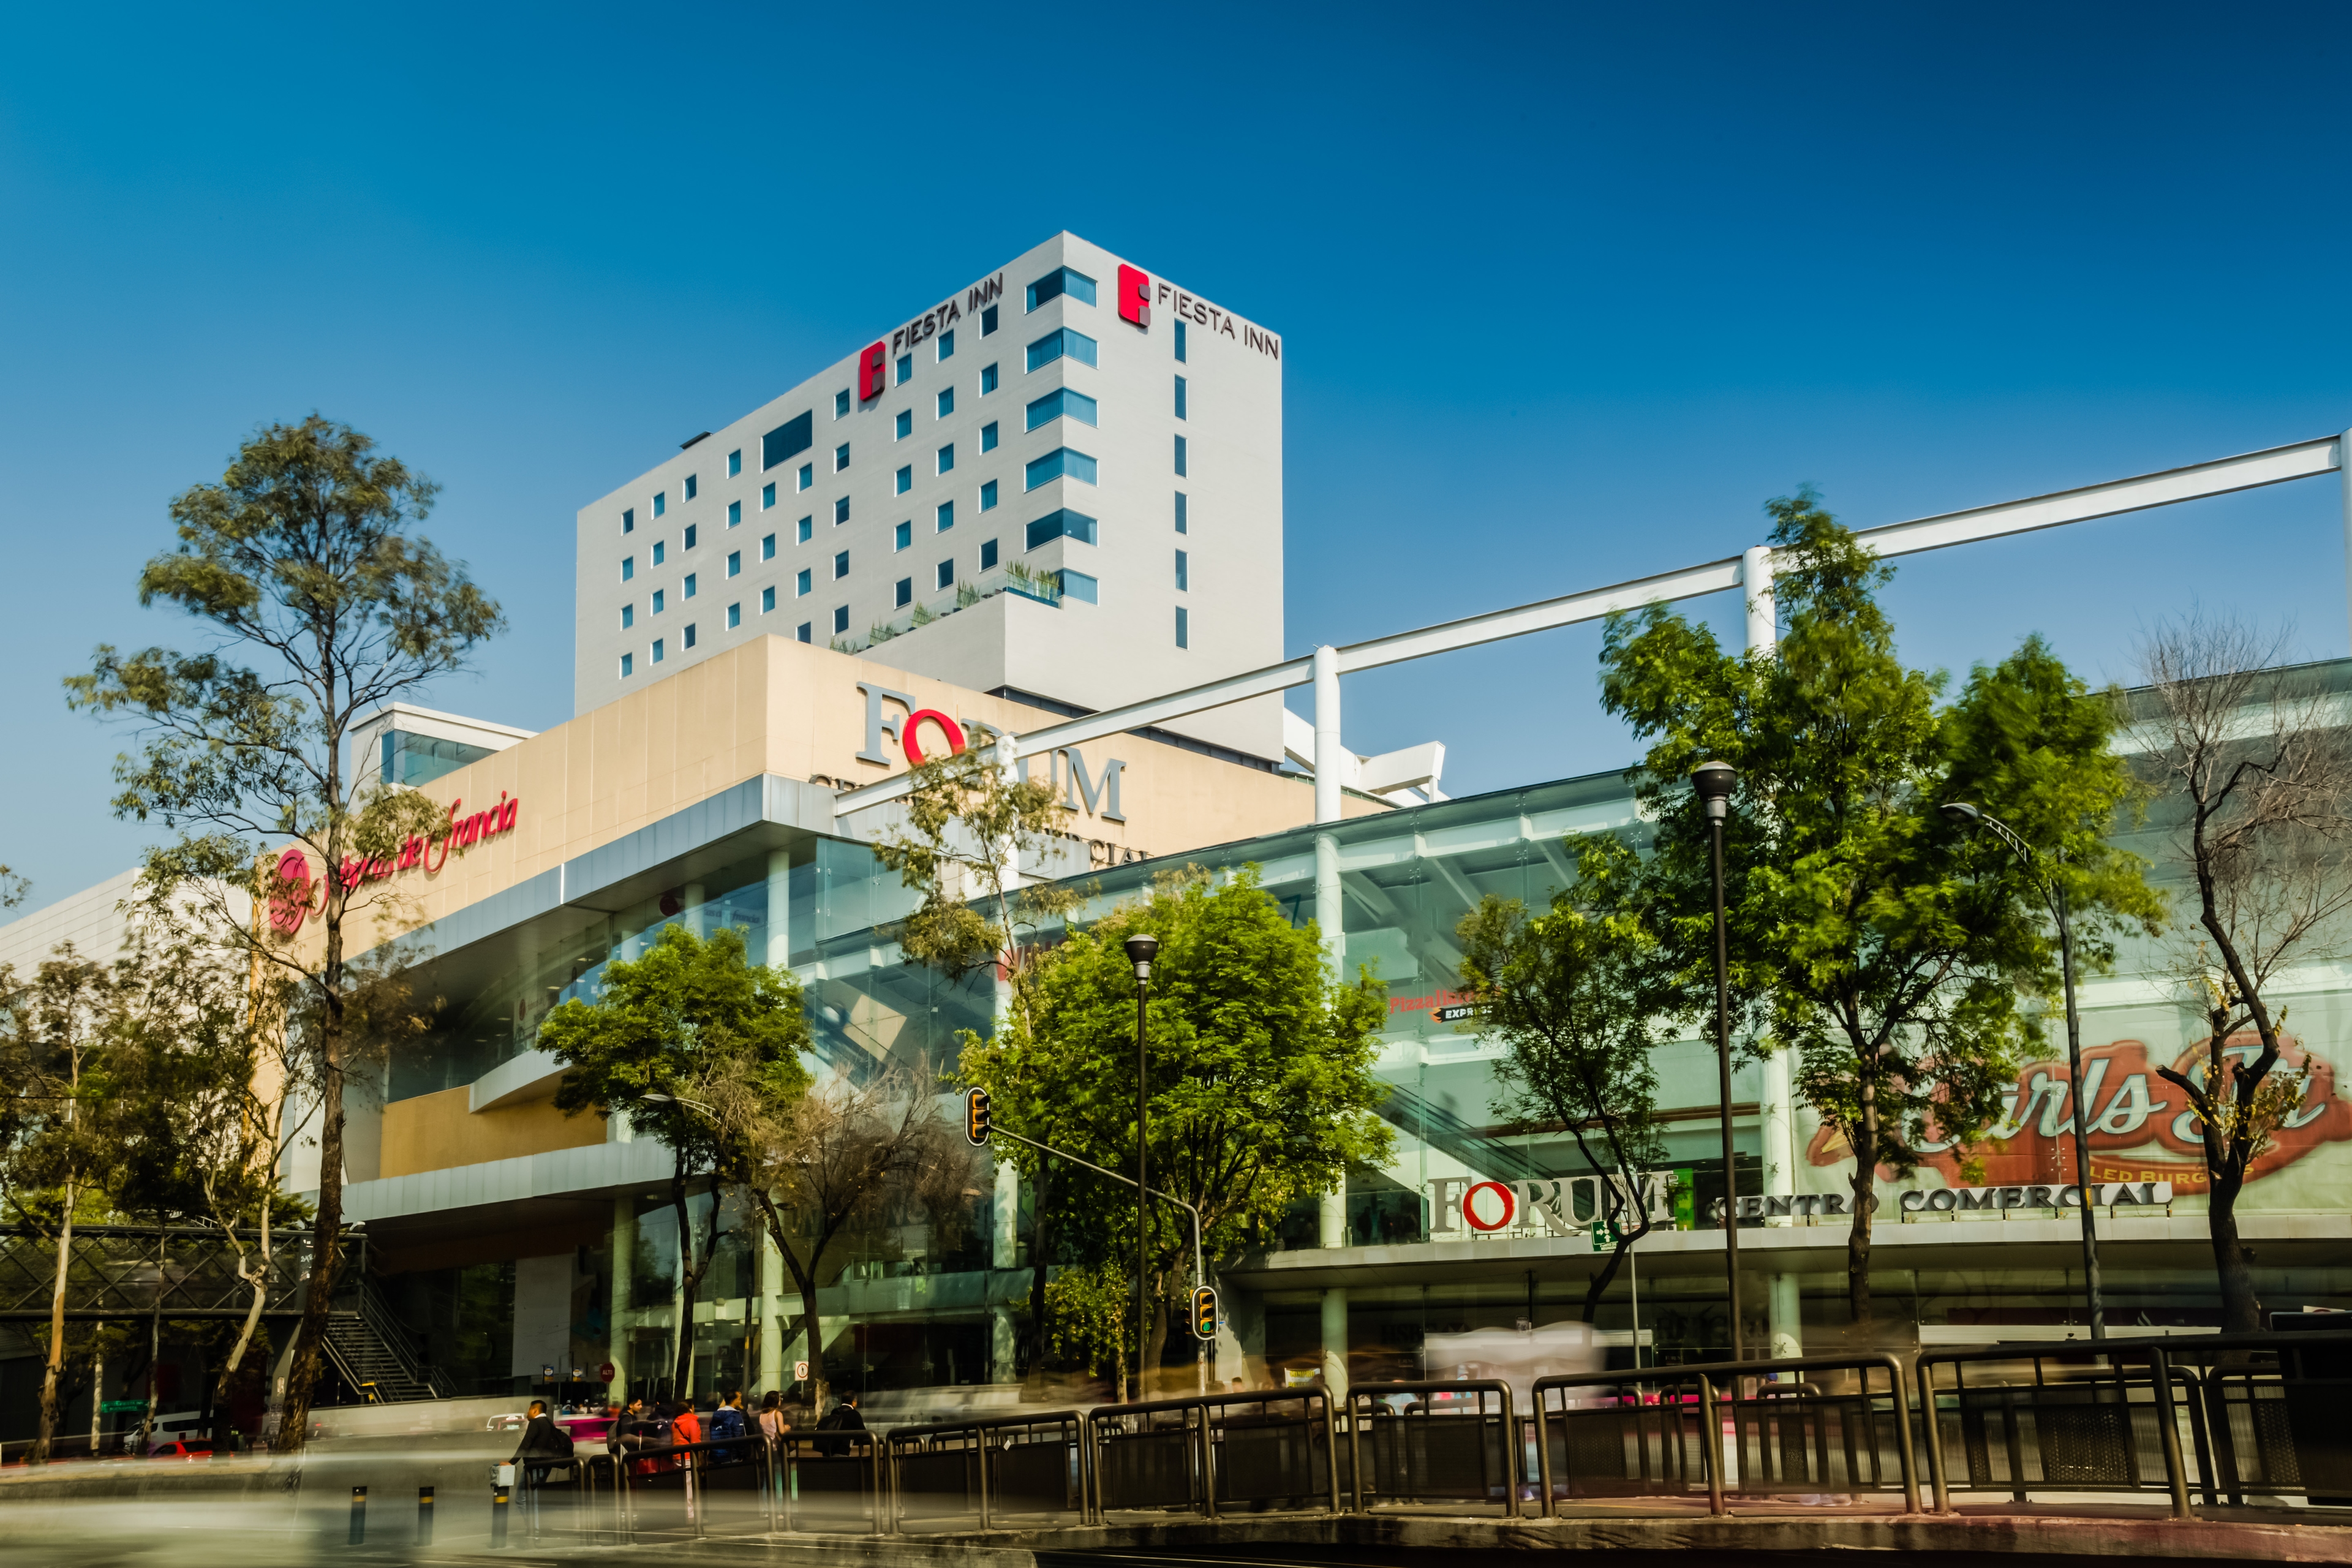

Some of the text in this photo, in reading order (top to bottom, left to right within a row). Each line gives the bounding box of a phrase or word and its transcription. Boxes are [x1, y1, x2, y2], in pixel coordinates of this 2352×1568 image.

[892, 272, 1003, 355] FIESTA INN
[1158, 283, 1279, 360] FIESTA INN
[424, 790, 518, 873] Francia
[1899, 1182, 2173, 1212] COMERCIAL
